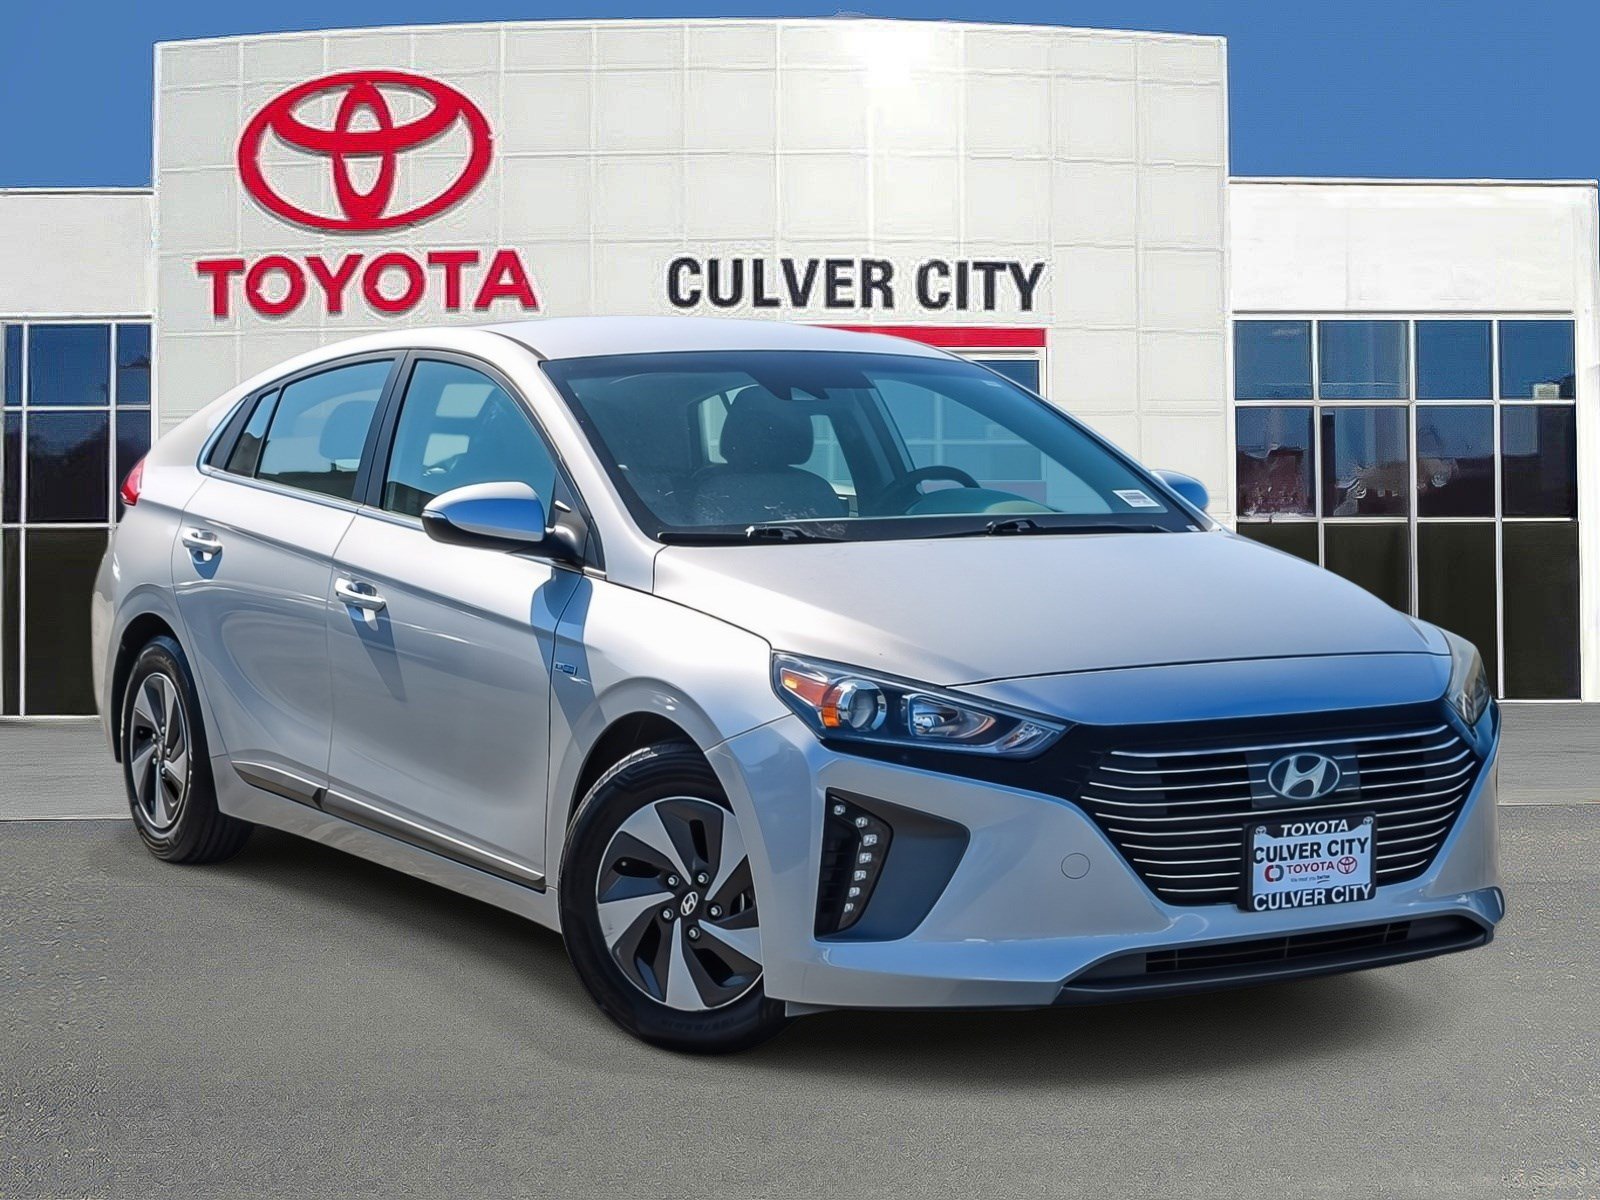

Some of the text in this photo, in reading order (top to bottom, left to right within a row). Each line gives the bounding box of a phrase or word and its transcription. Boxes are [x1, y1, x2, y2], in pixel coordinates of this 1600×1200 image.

[197, 249, 538, 318] TOYOTA
[668, 257, 1045, 310] CULVER CITY
[1281, 819, 1349, 837] TOYOTA
[1253, 837, 1369, 864] CULVER CITY
[1287, 861, 1335, 874] TOYOTA
[1254, 884, 1372, 911] CULVER CITY
